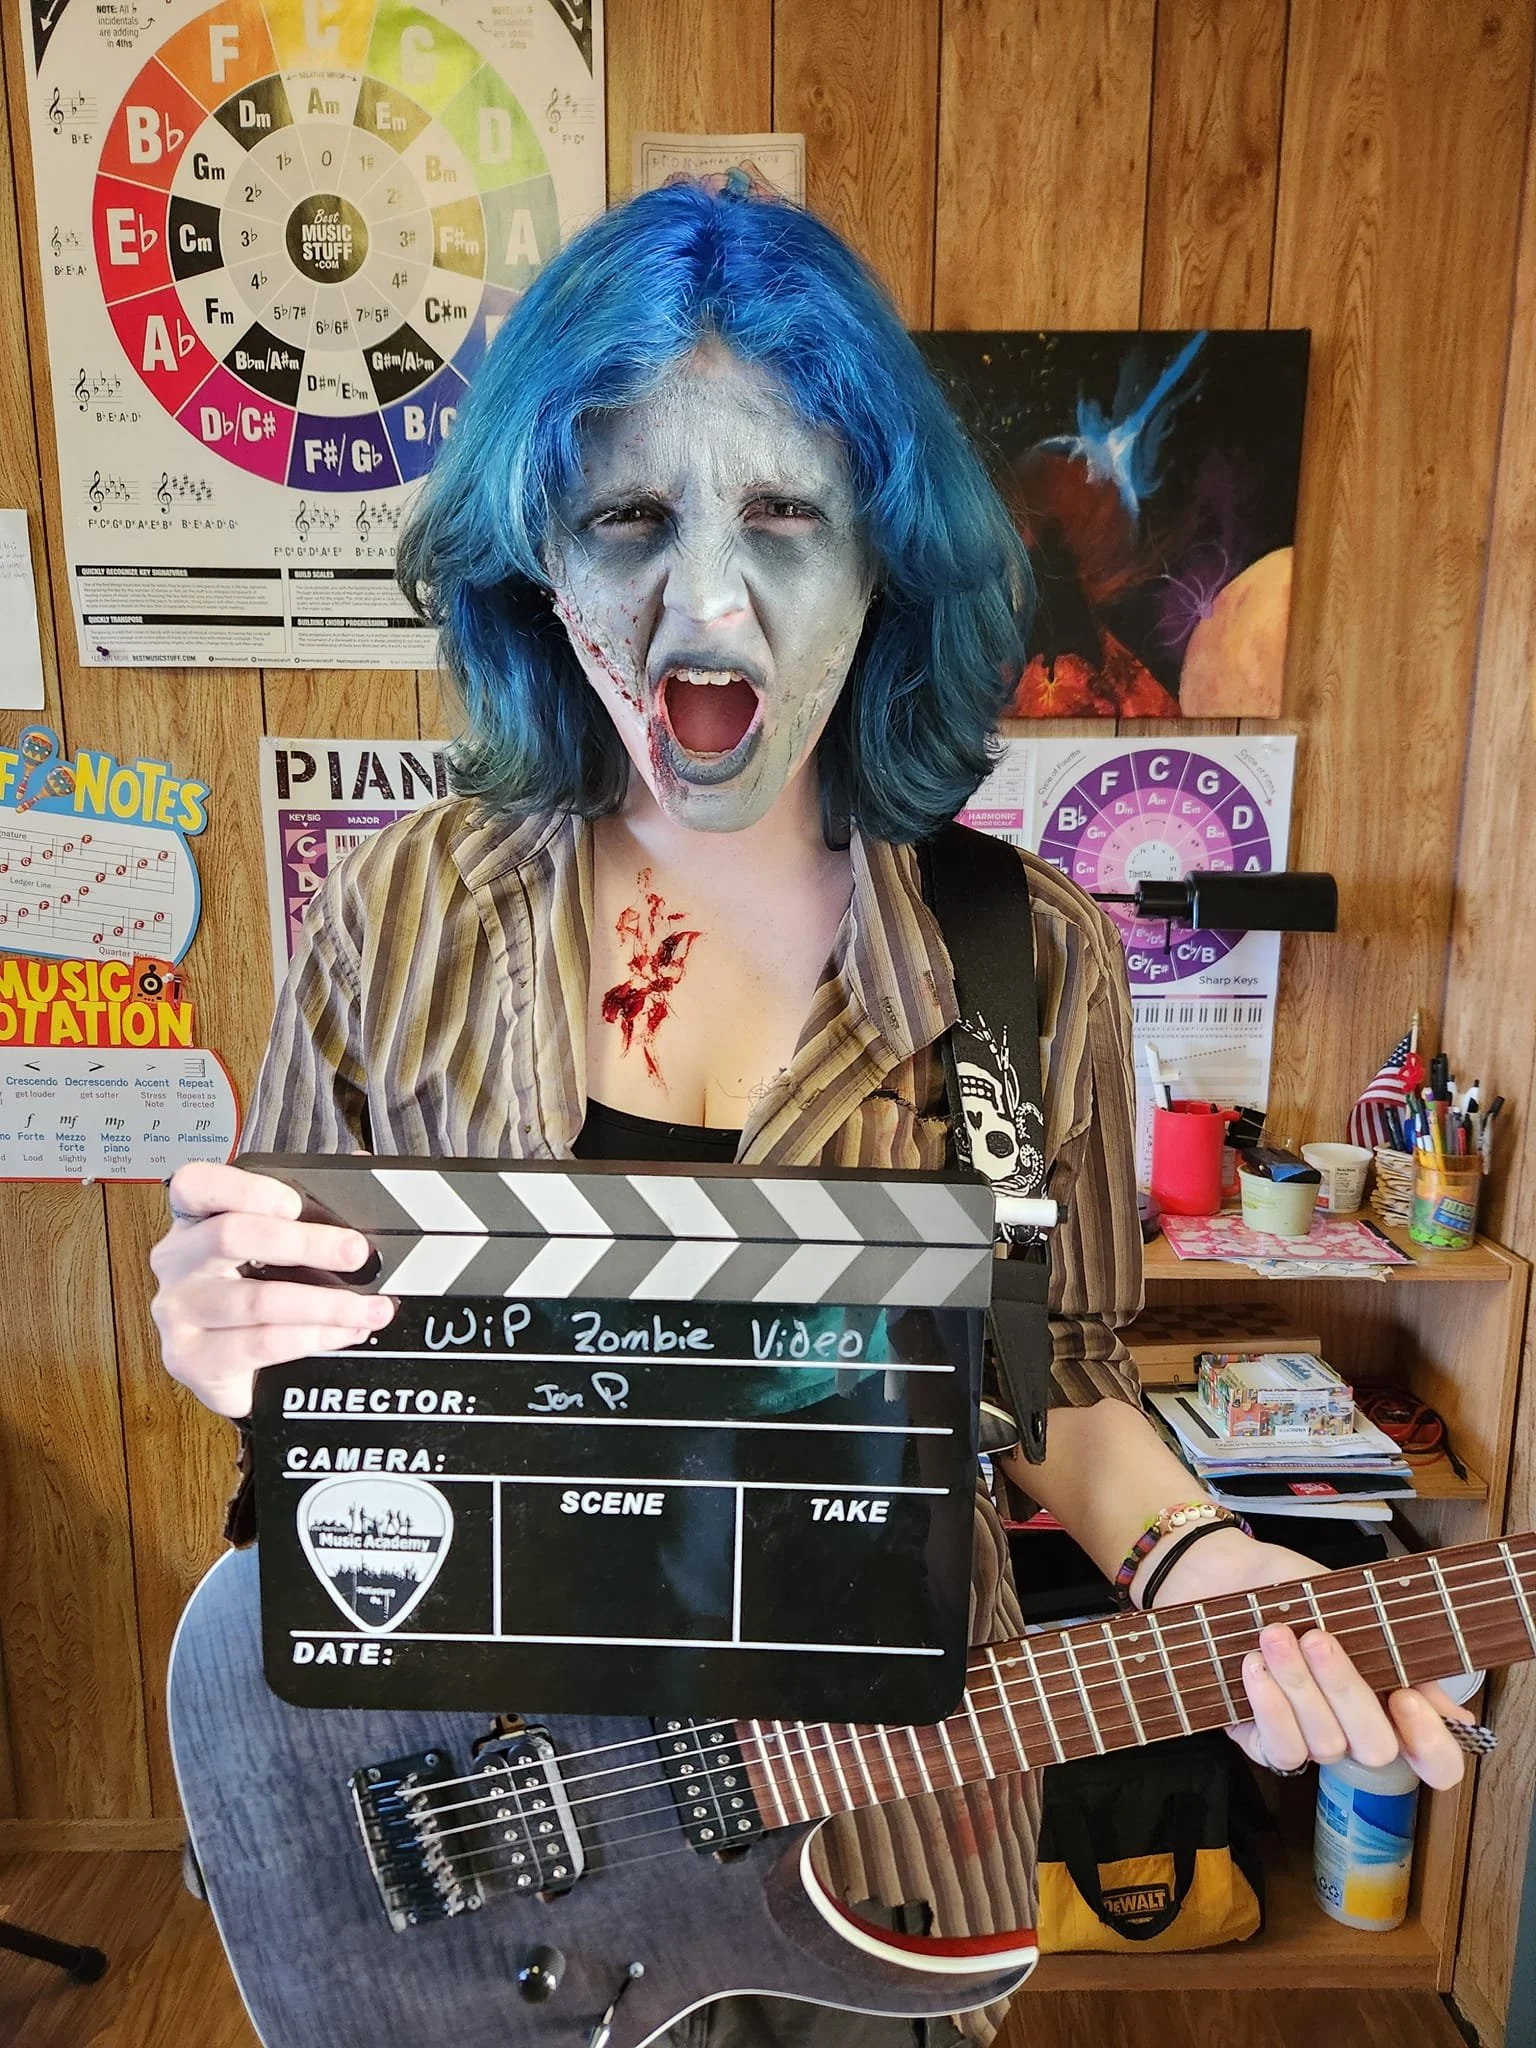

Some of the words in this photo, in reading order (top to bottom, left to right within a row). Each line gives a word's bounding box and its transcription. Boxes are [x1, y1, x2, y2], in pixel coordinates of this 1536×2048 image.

[96, 5, 117, 14] NOTE:
[119, 6, 130, 14] All
[98, 16, 139, 26] incidentals
[99, 29, 112, 37] are
[113, 28, 139, 39] adding
[107, 40, 114, 48] in
[115, 39, 133, 48] 4ths
[208, 24, 240, 83] F
[400, 25, 437, 87] G
[306, 87, 340, 115] Am
[238, 99, 272, 129] Dm
[375, 102, 408, 131] Em
[479, 107, 512, 164] D
[193, 153, 225, 181] Gm
[425, 155, 457, 183] Bm
[313, 208, 340, 225] Best
[178, 223, 213, 253] Cm
[301, 224, 353, 243] MUSIC
[505, 208, 541, 265] A
[302, 241, 353, 262] STUFF
[204, 297, 234, 325] Fm
[88, 616, 109, 625] QUICKLY
[132, 655, 196, 663] BESTMUSICSTUFF.COM
[1148, 755, 1171, 782] C
[1099, 770, 1120, 796] F
[1197, 769, 1220, 796] G
[74, 752, 208, 832] NOTES
[1147, 792, 1167, 806] Am
[1114, 802, 1133, 815] Dm
[1182, 800, 1201, 815] Em
[289, 813, 307, 823] KEY
[307, 814, 322, 823] SIG
[347, 816, 380, 825] MAJOR
[968, 813, 1018, 822] HARMONIC
[1232, 805, 1254, 830] D
[1086, 825, 1106, 839] Gm
[297, 836, 318, 858] C
[1075, 862, 1095, 875] Cm
[10, 876, 34, 888] Ledger
[36, 881, 52, 890] Line
[98, 946, 131, 959] Quarter
[0, 960, 131, 1003] MUSIC
[1198, 976, 1232, 986] Sharp
[1233, 976, 1259, 986] Keys
[6, 1076, 58, 1086] Crescendo
[65, 1077, 129, 1087] Decrescendo
[134, 1078, 169, 1088] Accent
[178, 1078, 214, 1089] Repeat
[15, 1091, 28, 1099] get
[30, 1090, 55, 1098] louder
[80, 1091, 93, 1099] get
[95, 1091, 119, 1099] softer
[141, 1091, 166, 1099] Stress
[176, 1091, 206, 1101] Repeat
[144, 1100, 164, 1108] Note
[181, 1100, 214, 1108] directed
[59, 1115, 79, 1129] mf
[105, 1116, 125, 1130] mp
[152, 1119, 161, 1131] p
[195, 1119, 211, 1131] pp
[17, 1132, 45, 1141] Forte
[55, 1133, 86, 1142] Mezzo
[100, 1133, 131, 1142] Mezzo
[143, 1133, 170, 1143] Piano
[178, 1133, 229, 1143] Pianissimo
[59, 1142, 85, 1152] forte
[103, 1144, 130, 1154] piano
[23, 1154, 43, 1162] Loud
[58, 1155, 87, 1164] slightly
[104, 1155, 132, 1164] slightly
[150, 1155, 166, 1163] soft
[65, 1165, 82, 1173] loud
[571, 1310, 715, 1354] Zombie
[751, 1318, 863, 1360] Video
[283, 1387, 476, 1414] DIRECTOR:
[286, 1446, 446, 1472] CAMERA:
[559, 1490, 666, 1517] SCENE
[810, 1497, 890, 1524] TAKE
[318, 1532, 362, 1549] Music
[363, 1533, 430, 1553] Academy
[292, 1641, 393, 1666] DATE:
